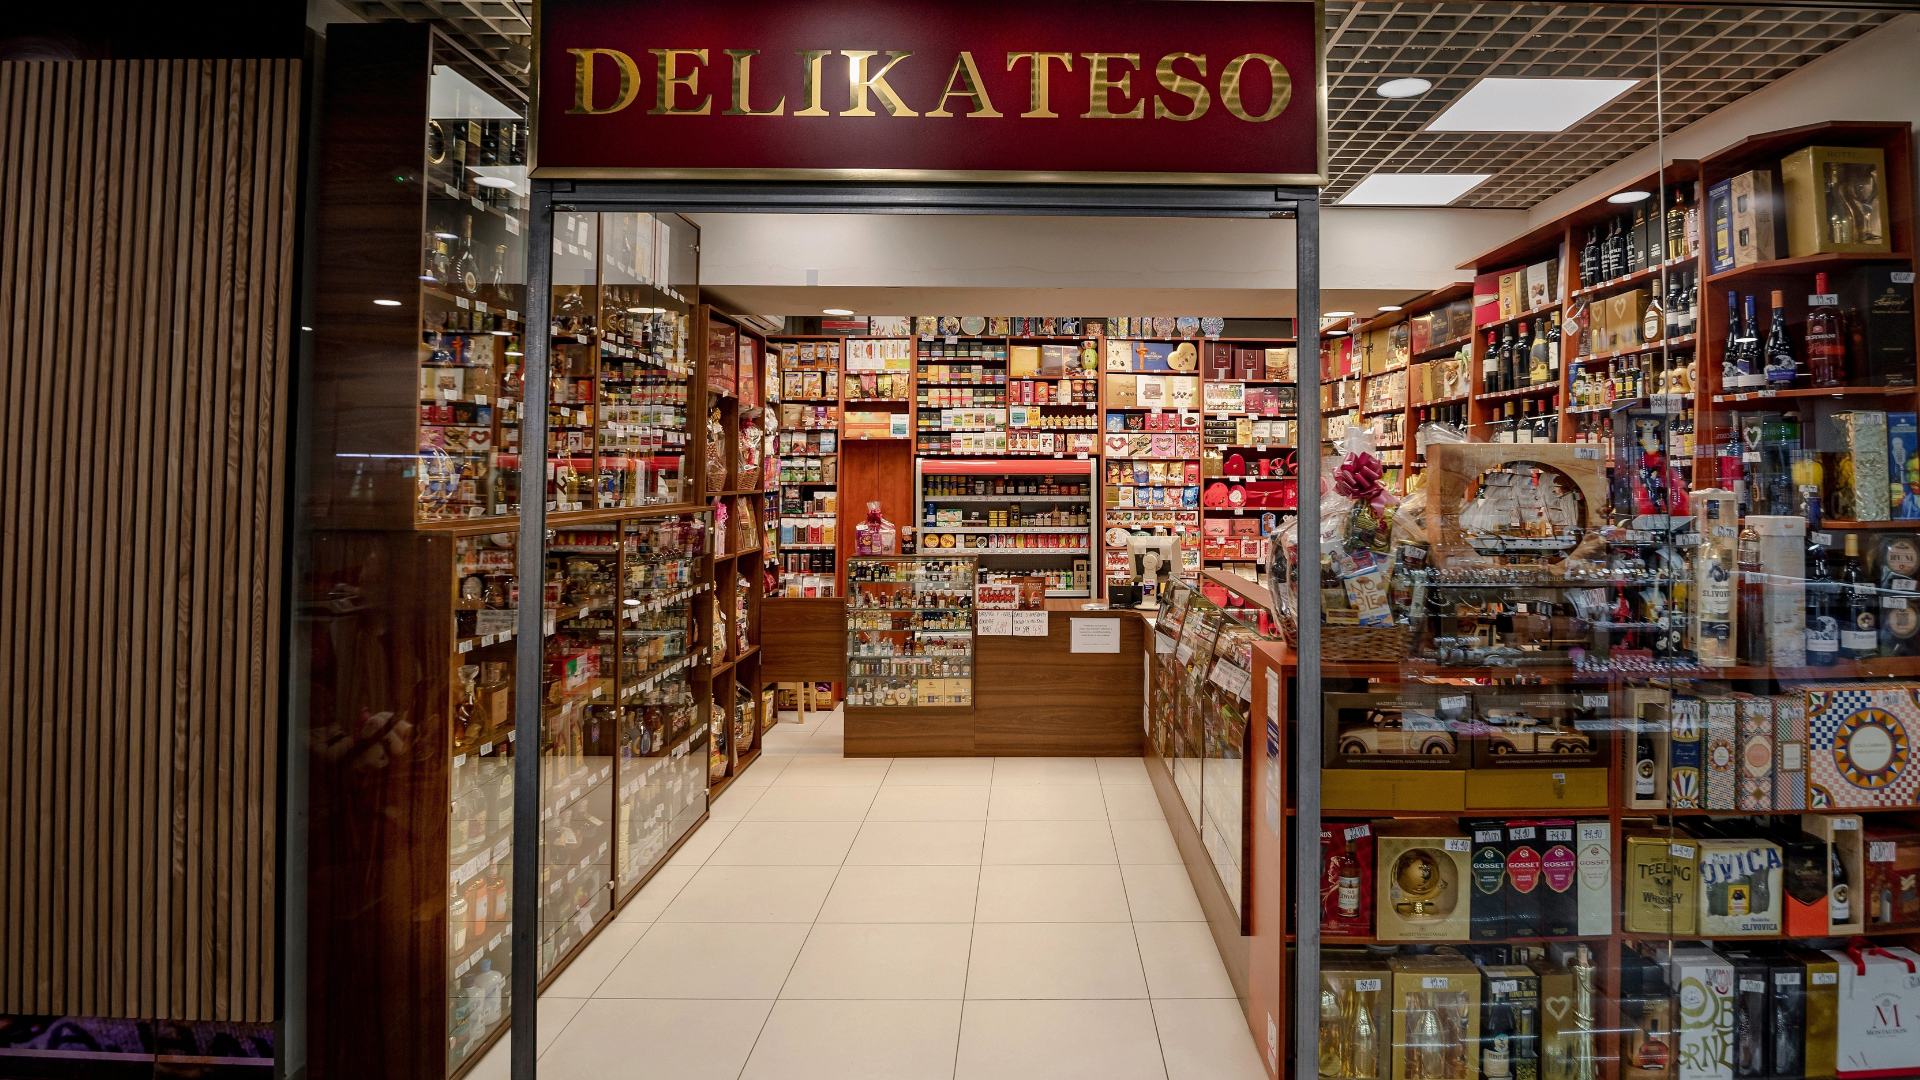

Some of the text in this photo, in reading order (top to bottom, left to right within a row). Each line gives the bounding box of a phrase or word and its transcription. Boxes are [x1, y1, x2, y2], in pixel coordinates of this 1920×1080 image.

[565, 48, 1293, 123] DELIKATESO
[1508, 861, 1540, 869] GOSSET
[1638, 862, 1692, 881] TEELNG
[1742, 923, 1778, 931] SLIVOVICA
